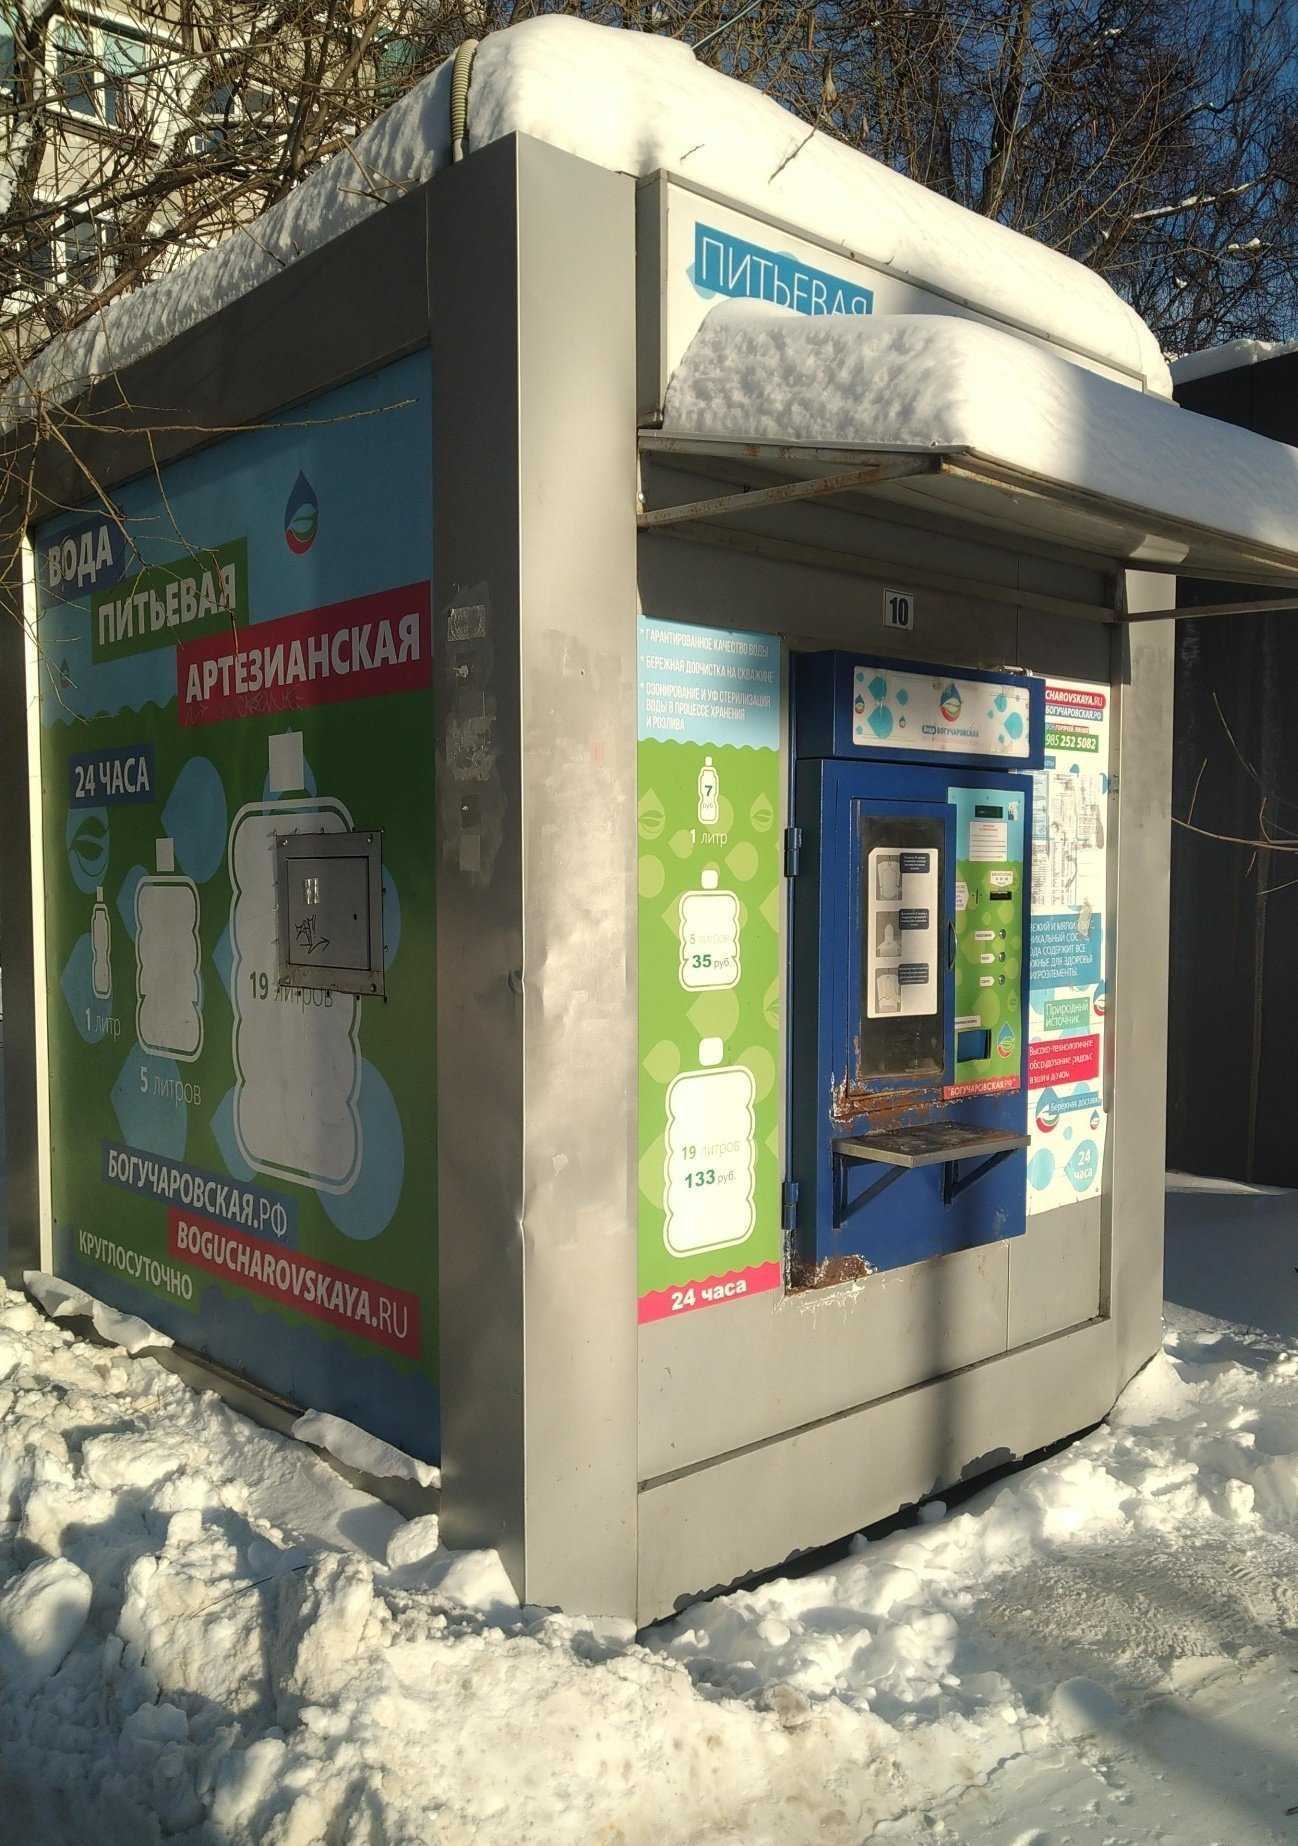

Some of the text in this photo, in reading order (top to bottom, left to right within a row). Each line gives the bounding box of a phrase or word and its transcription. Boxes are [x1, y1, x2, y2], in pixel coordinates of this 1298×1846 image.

[48, 525, 113, 588] ВОДА
[98, 562, 236, 646] ПИТЬЕВАЯ
[889, 596, 909, 626] 10
[645, 628, 712, 650] ГАРАНТИРОВАННОЕ
[713, 638, 747, 656] КАЧЕСТВО
[185, 612, 420, 704] АРТЕЗИАНСКАЯ
[646, 655, 685, 673] БЕРЕЖНАЯ
[1060, 735, 1076, 748] 252
[1077, 737, 1097, 750] 5082
[75, 757, 150, 798] 24 ЧАСА
[704, 784, 713, 797] 7
[689, 828, 728, 848] 1 литр
[692, 954, 712, 969] 35
[249, 970, 269, 1001] 19
[86, 1007, 121, 1041] 1 литр
[140, 1065, 201, 1108] 5 литров
[681, 1144, 697, 1161] 19
[1077, 1148, 1092, 1166] 24
[108, 1149, 288, 1238] БОГУЧАРОВСКАЯ.РФ
[685, 1169, 716, 1189] 133
[79, 1229, 193, 1301] КРУГЛОСУТОЧНО
[177, 1220, 408, 1339] BOGUCHAROVSKAYA.RU
[671, 1279, 748, 1311] 24 часа
